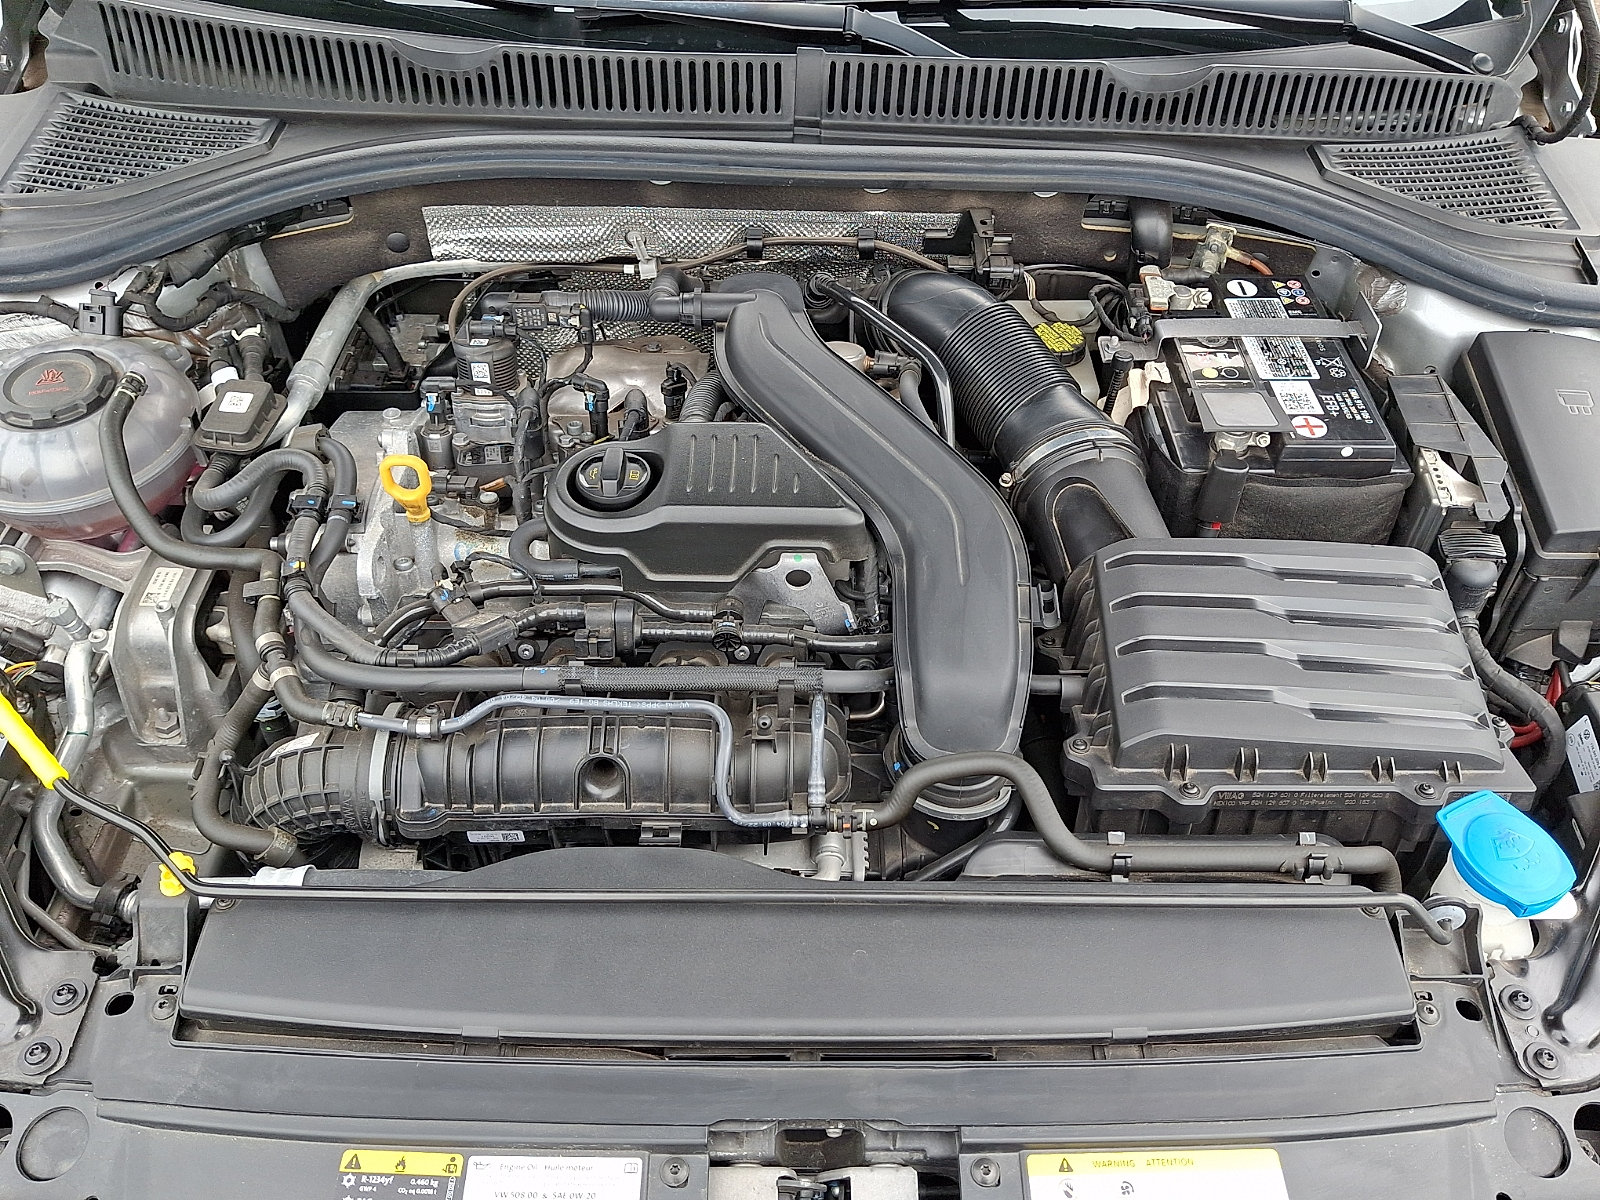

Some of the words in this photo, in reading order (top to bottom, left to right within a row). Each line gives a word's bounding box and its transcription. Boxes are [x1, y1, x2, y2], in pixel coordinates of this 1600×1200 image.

[1318, 394, 1340, 418] EFB+
[1354, 399, 1366, 409] 915
[601, 700, 632, 708] TEKLAS
[499, 1163, 525, 1172] Engine
[527, 1163, 538, 1171] Oil
[566, 1164, 593, 1172] moteur
[1092, 1160, 1136, 1168] WARNING
[1146, 1158, 1194, 1167] ATTENTION
[361, 1175, 394, 1186] R-1234yf
[410, 1178, 429, 1186] 0.460
[430, 1178, 439, 1188] kg
[494, 1191, 508, 1199] VW
